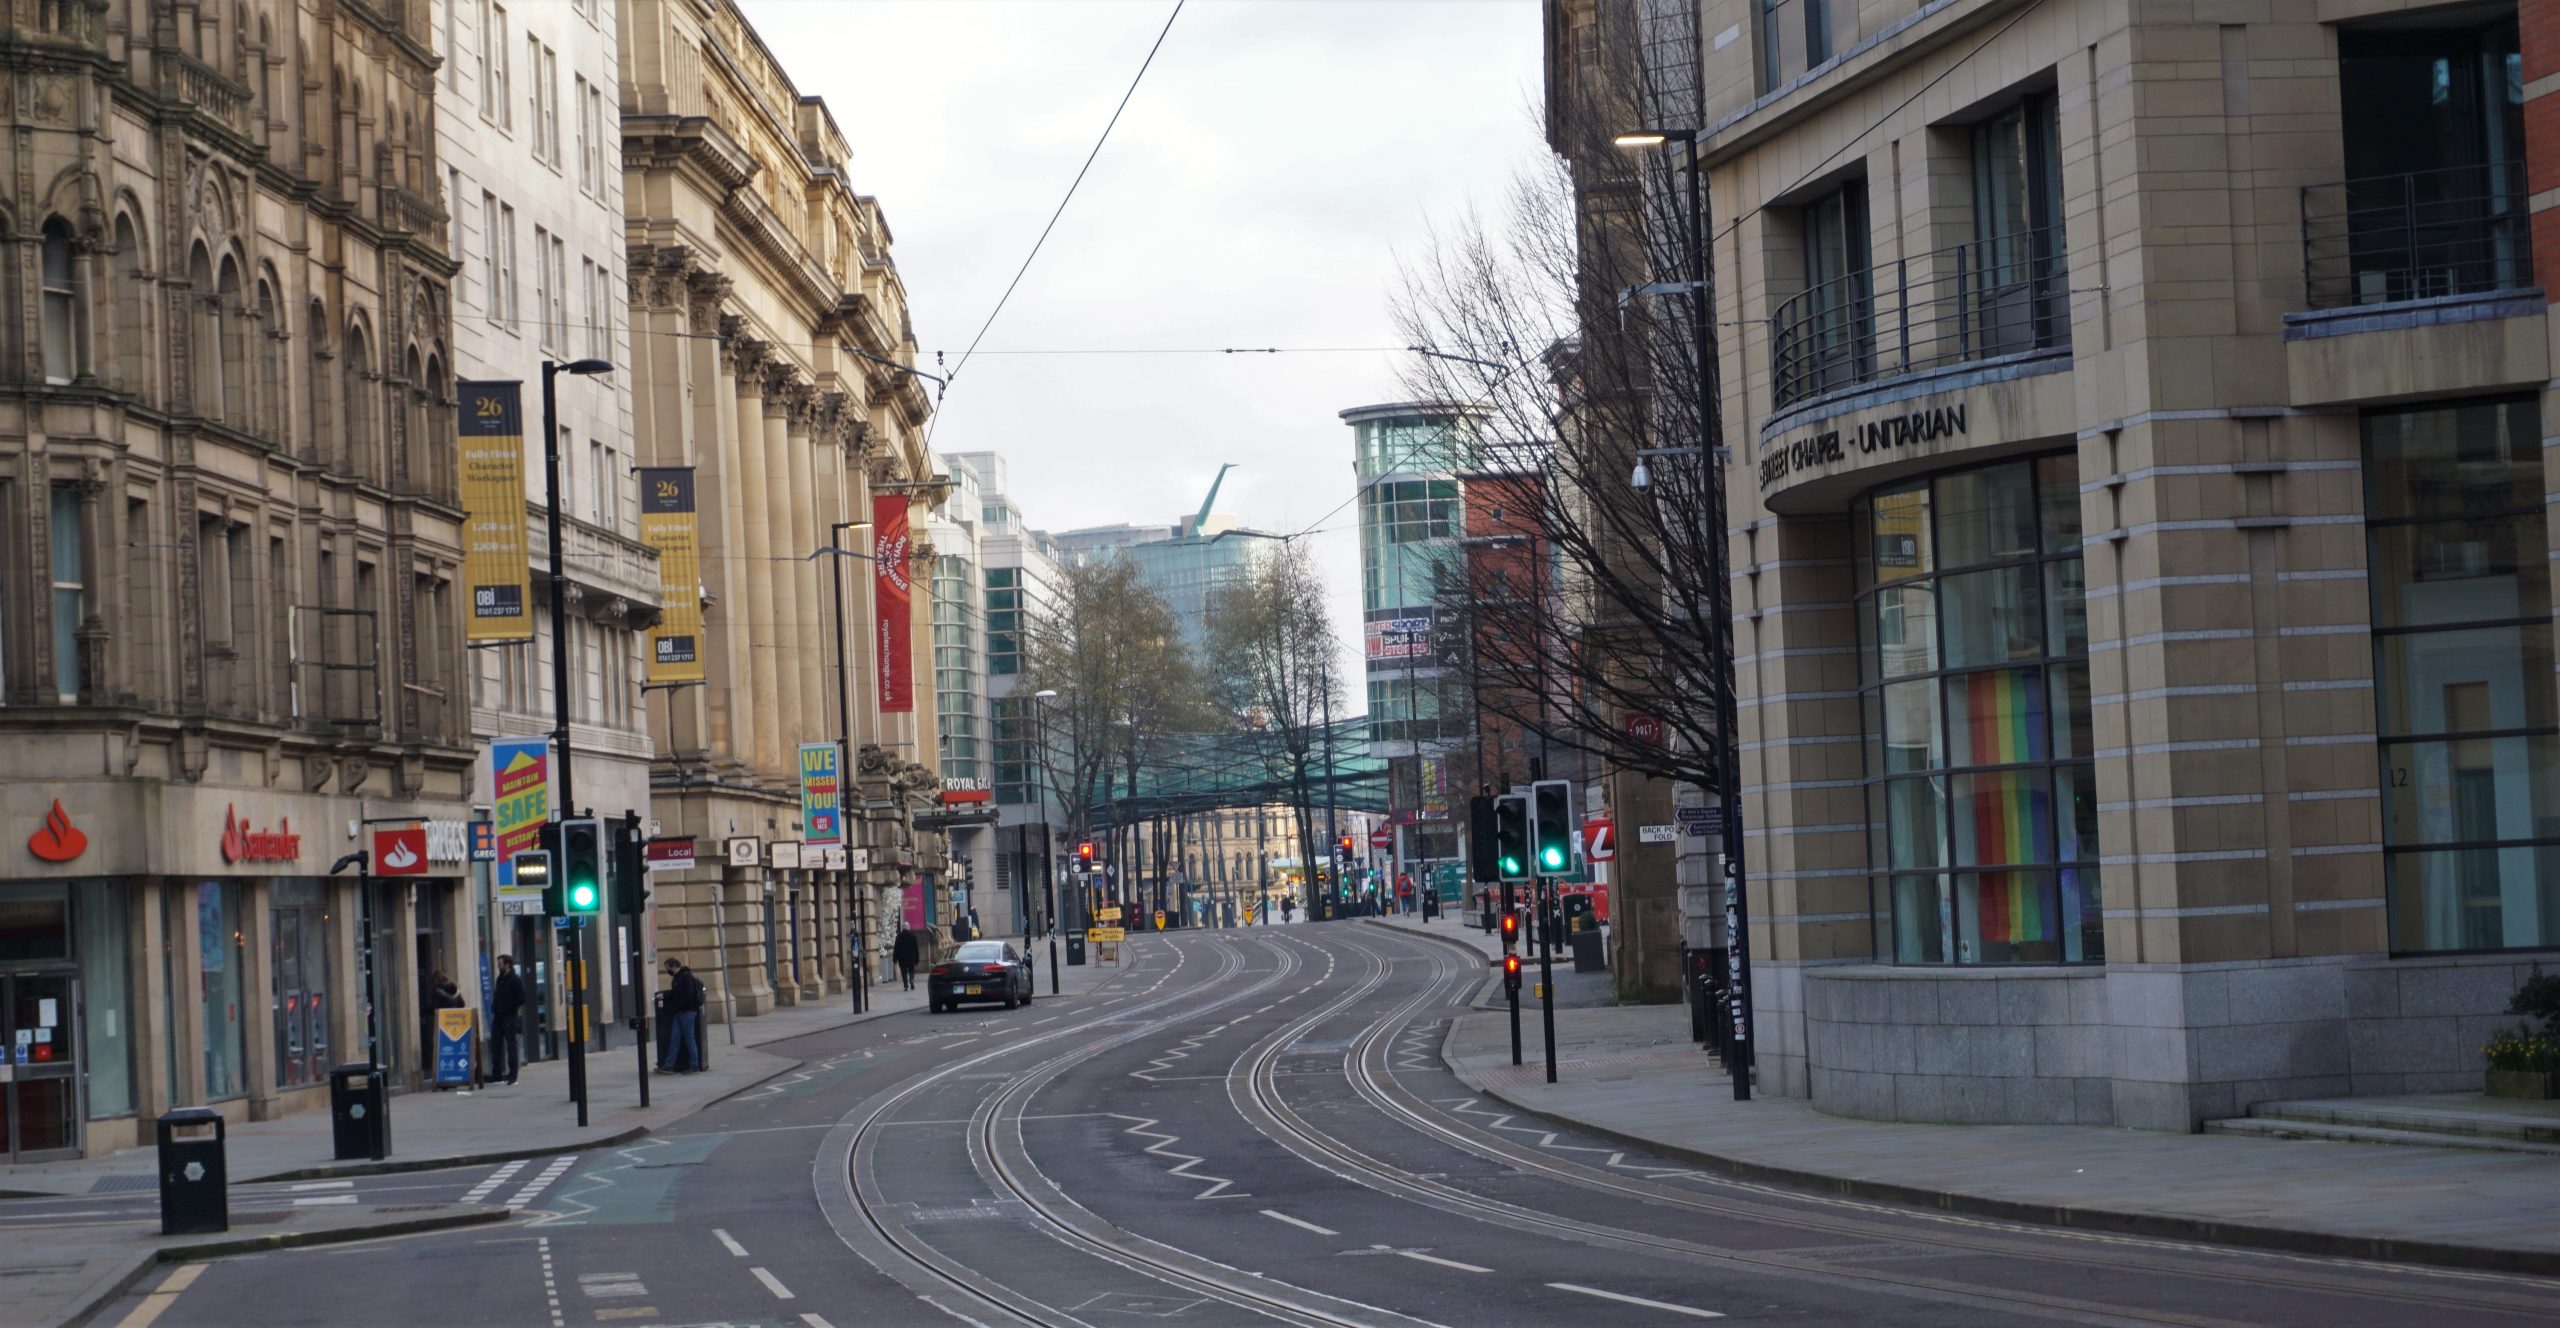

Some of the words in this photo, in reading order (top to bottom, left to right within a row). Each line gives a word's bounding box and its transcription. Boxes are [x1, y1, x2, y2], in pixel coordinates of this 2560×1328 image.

[476, 397, 502, 416] 26
[1791, 431, 1845, 471] CHAPEL
[1858, 403, 1966, 454] UNITARIAN
[468, 461, 515, 471] Character
[467, 473, 517, 484] Workspace
[656, 480, 679, 497] 26
[477, 607, 493, 615] 0161
[493, 607, 505, 615] 237
[505, 606, 520, 614] 1717
[881, 619, 893, 702] royalexchange.co.uk
[803, 750, 835, 771] WE
[502, 772, 539, 793] MAINTAIN
[805, 776, 836, 787] MISSED
[947, 777, 976, 791] ROYAL
[497, 789, 546, 828] SAFE
[806, 792, 836, 809] YOU!
[242, 816, 300, 860] Santander
[1642, 826, 1662, 834] BACK
[1654, 833, 1672, 841] FOLD
[422, 820, 467, 861] GREGGS
[668, 847, 692, 857] Local
[505, 901, 520, 913] 26
